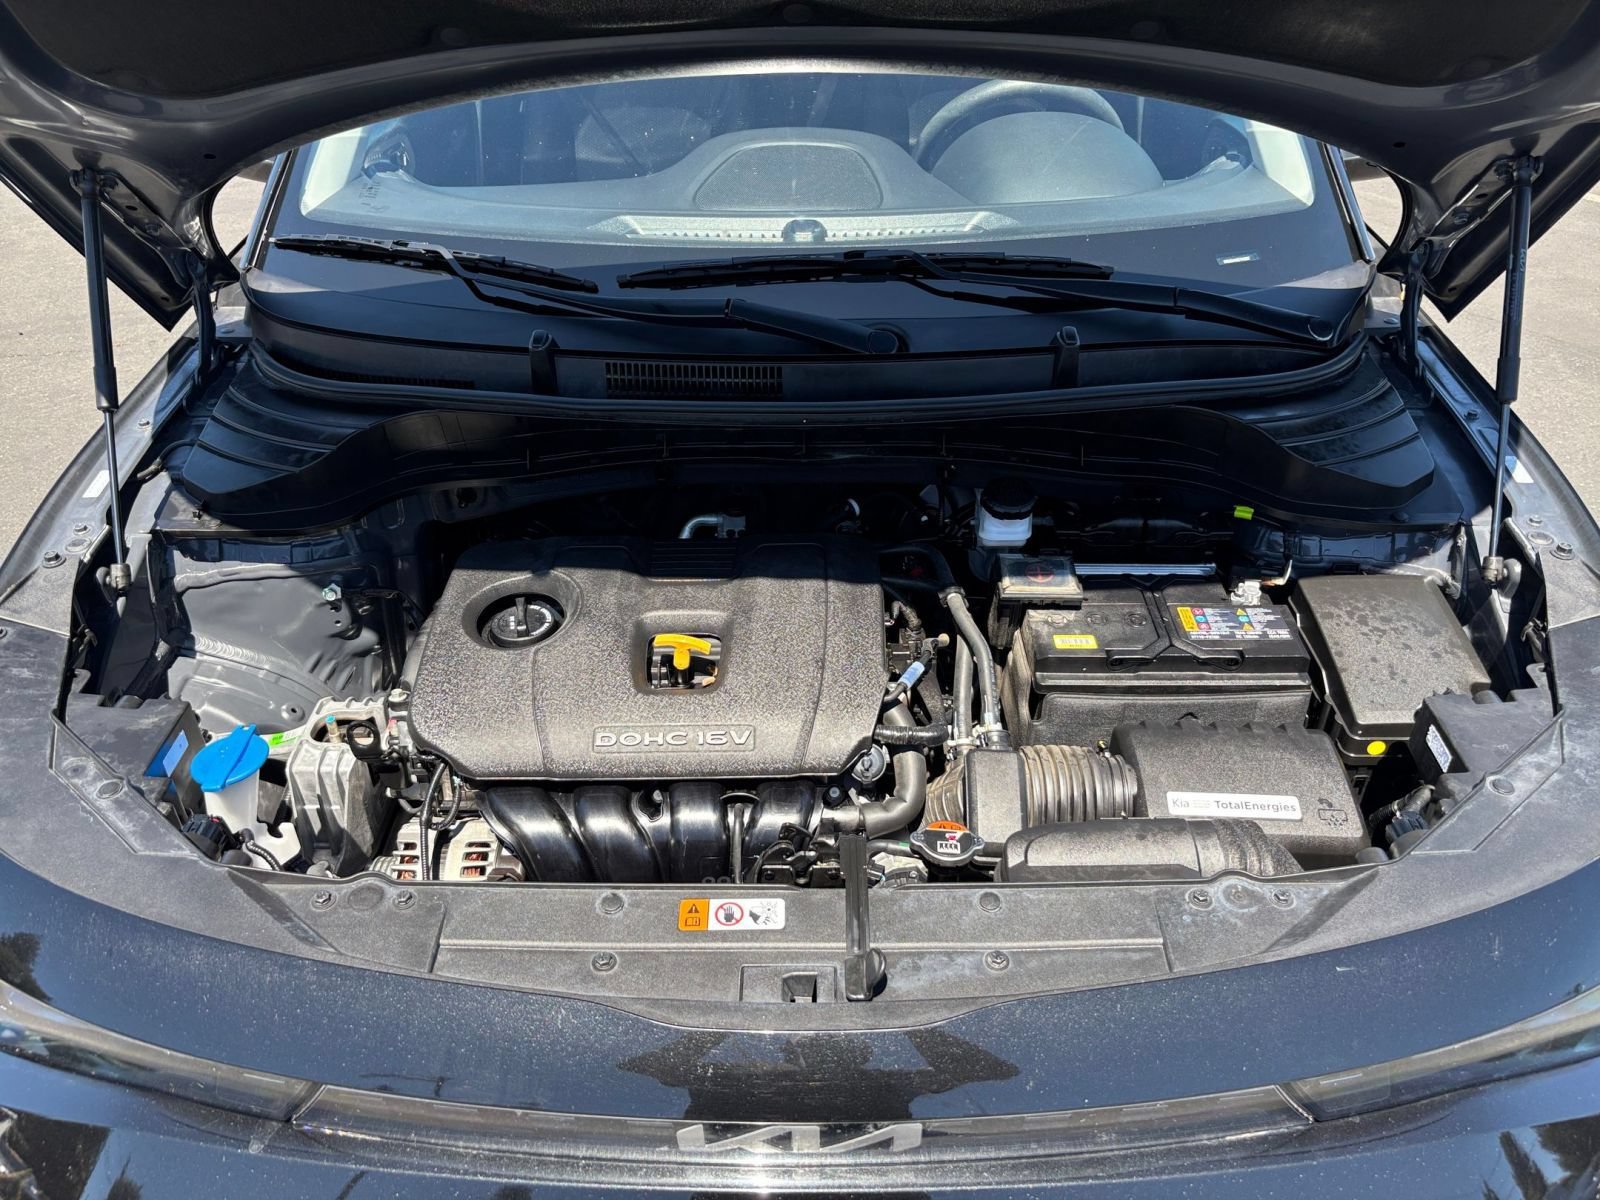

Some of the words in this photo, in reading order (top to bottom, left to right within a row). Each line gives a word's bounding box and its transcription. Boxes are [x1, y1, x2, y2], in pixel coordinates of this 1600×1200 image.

[594, 731, 688, 747] DOHC
[697, 729, 753, 746] 16V
[1171, 797, 1190, 809] Kia
[1214, 799, 1297, 813] TotalEnergies
